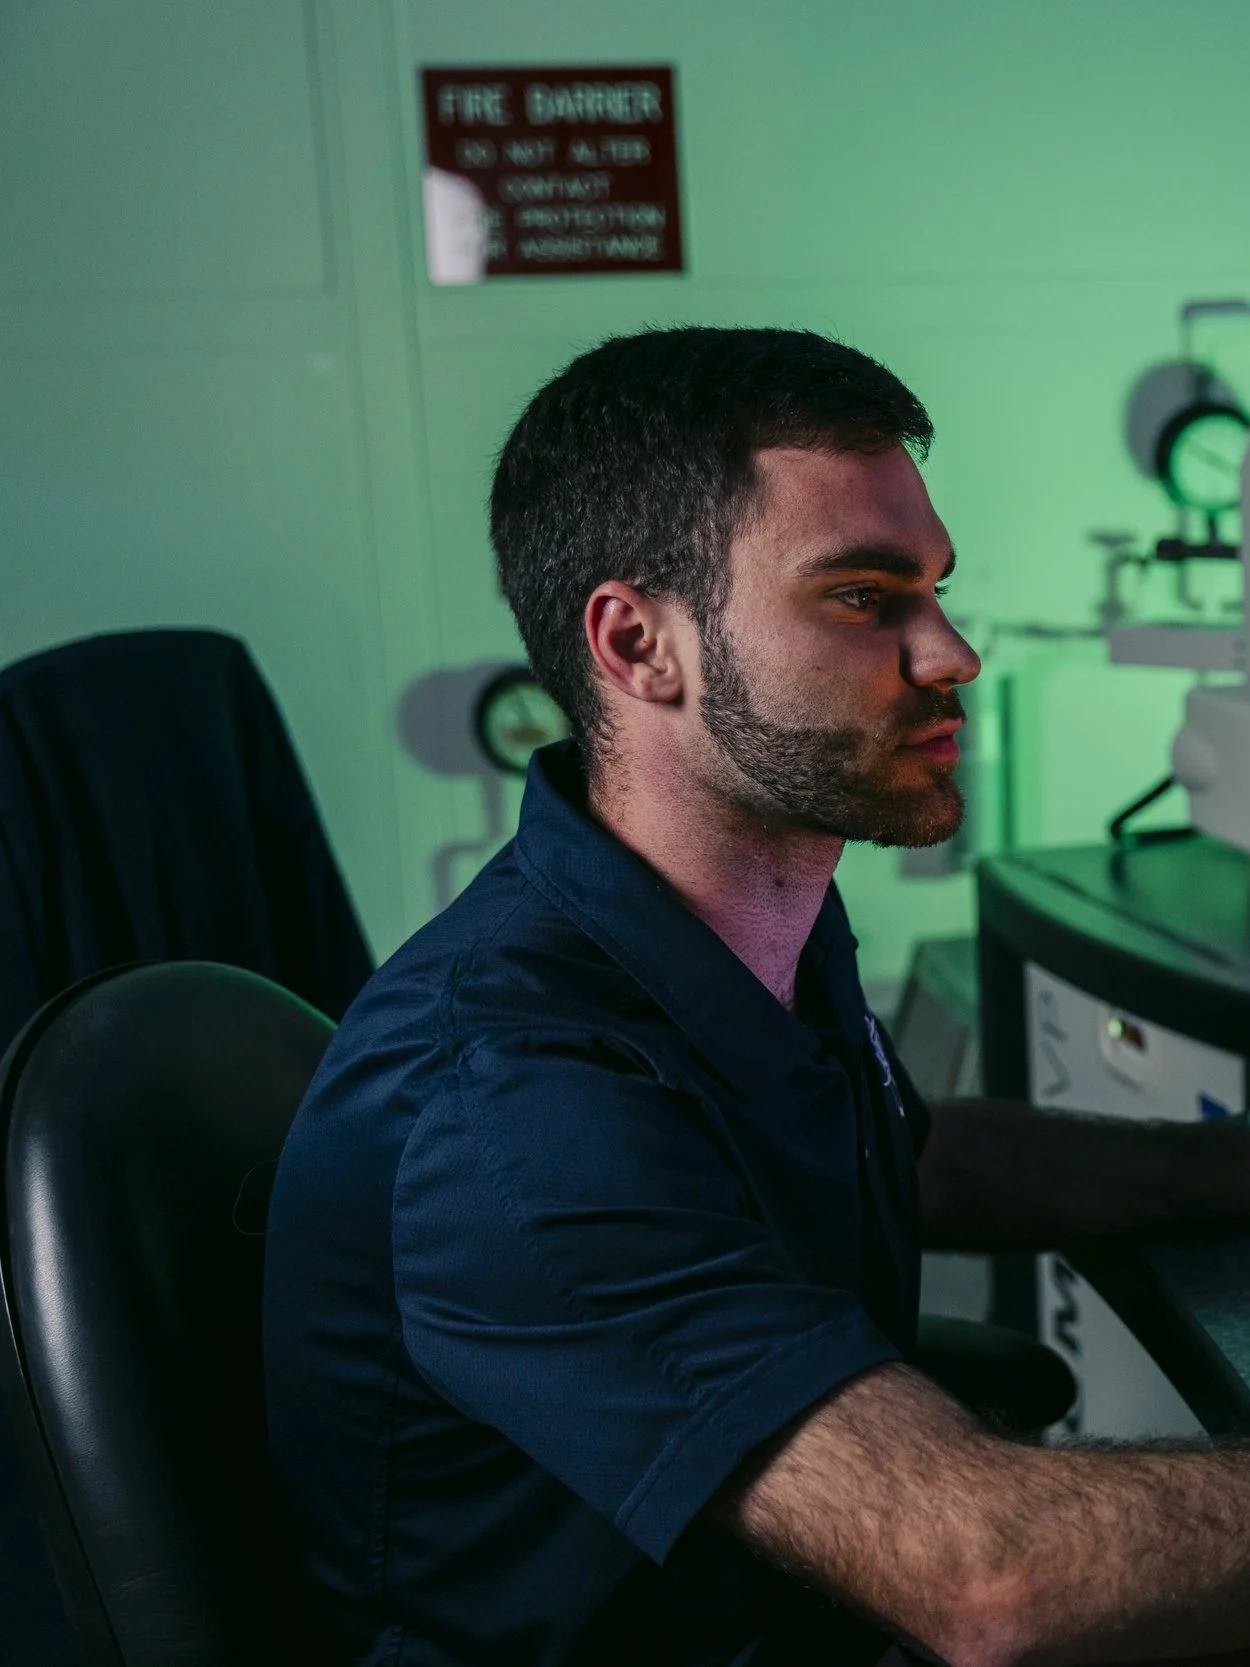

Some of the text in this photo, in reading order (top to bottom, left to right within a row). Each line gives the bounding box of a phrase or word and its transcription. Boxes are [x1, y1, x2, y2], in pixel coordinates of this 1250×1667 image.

[438, 82, 661, 125] FIRE BARRIER
[456, 135, 650, 167] DO NOT ALTER
[499, 173, 611, 202] CONTACT
[514, 202, 665, 233] PROTECTION
[517, 233, 665, 261] ASSISTANCE
